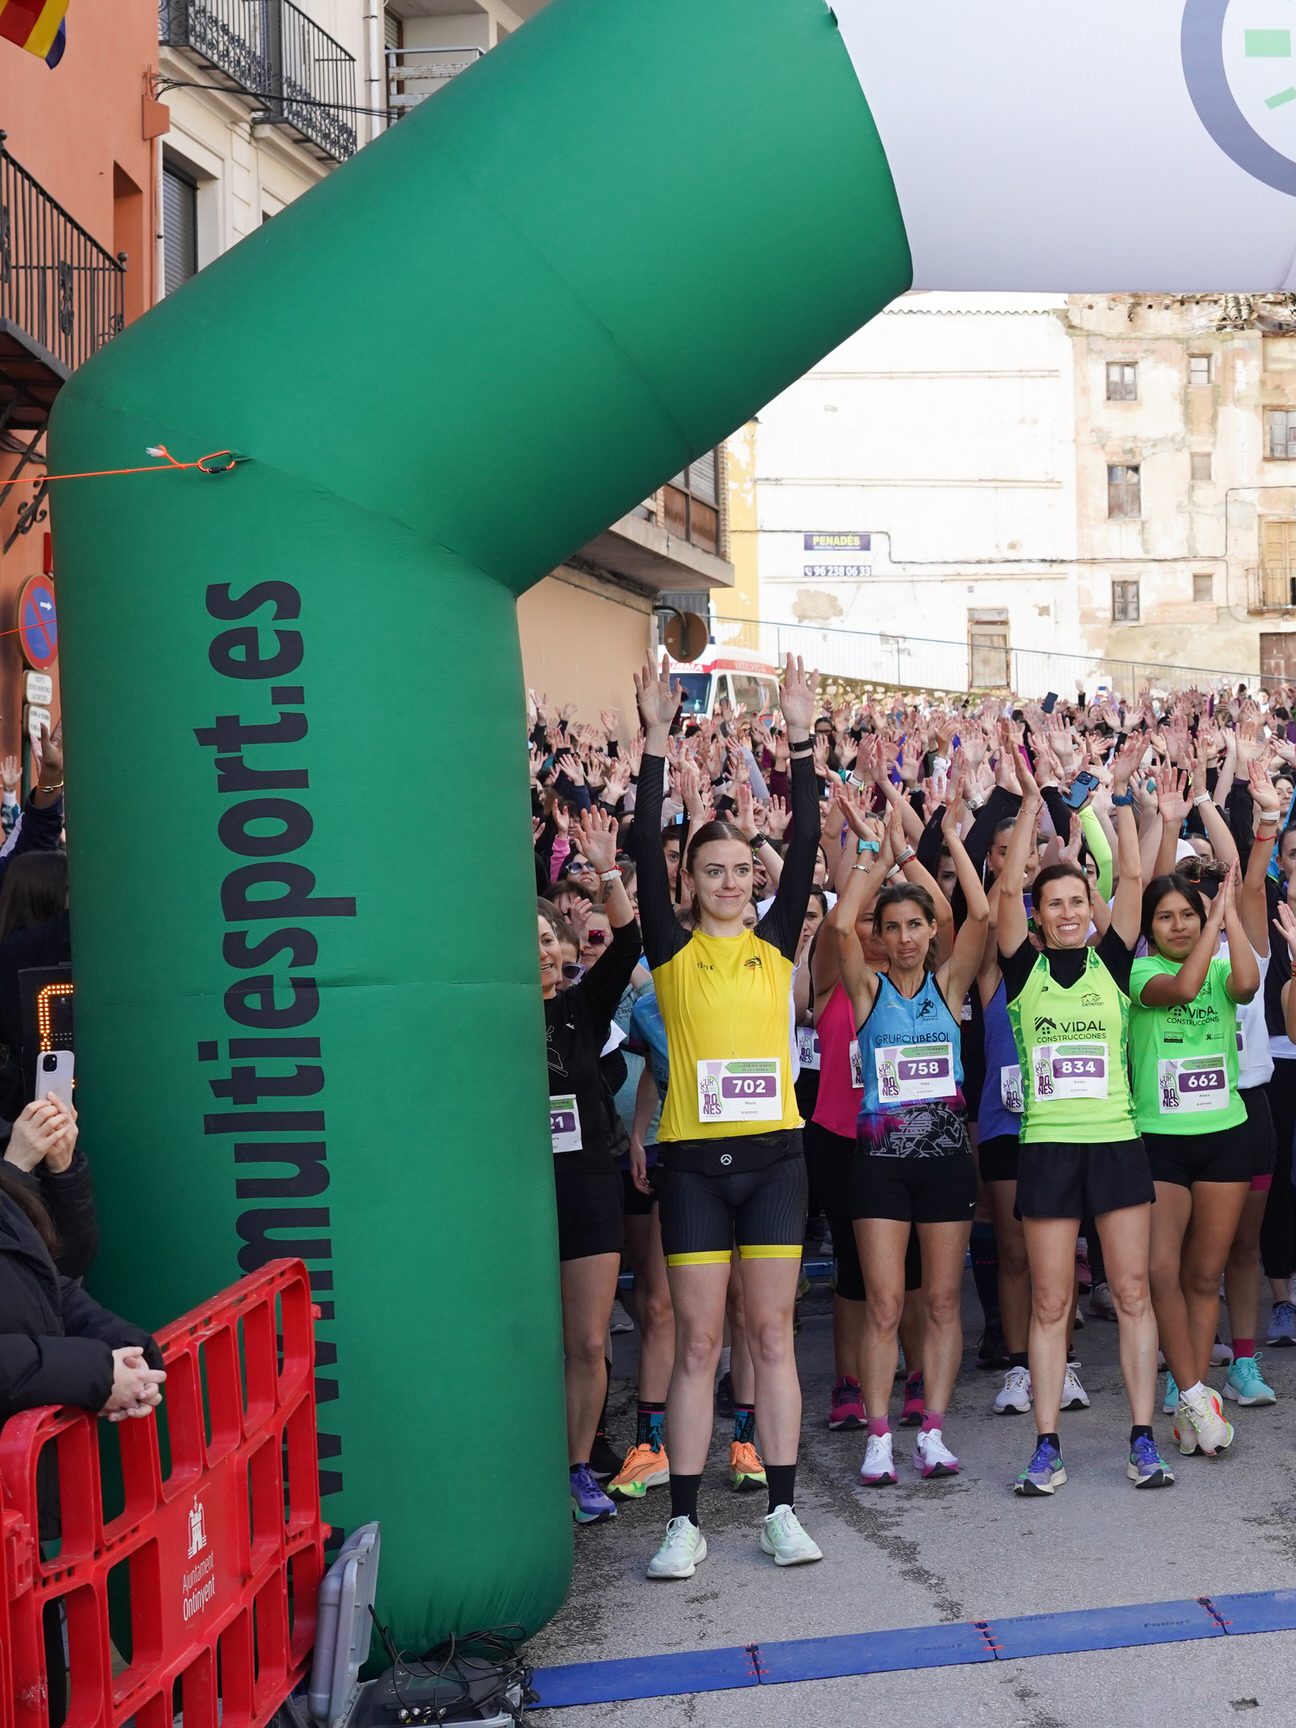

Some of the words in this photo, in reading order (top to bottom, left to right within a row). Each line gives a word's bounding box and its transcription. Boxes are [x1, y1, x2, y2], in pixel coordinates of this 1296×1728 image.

[812, 534, 860, 546] PENADÉS
[813, 566, 826, 576] 96
[827, 566, 845, 576] 238
[846, 566, 858, 576] 06
[859, 566, 870, 576] 33
[1060, 1020, 1106, 1033] VIDAL
[875, 1032, 951, 1045] GRUPOUBESOL
[1036, 1033, 1107, 1043] CONSTRUCCIONES
[907, 1062, 939, 1076] 758
[1062, 1061, 1096, 1074] 834
[732, 1079, 766, 1094] 702
[1188, 1073, 1218, 1088] 662
[192, 579, 357, 1598] .multiesport.es
[182, 1550, 214, 1597] Ajuntament
[183, 1573, 215, 1621] Ontinyent
